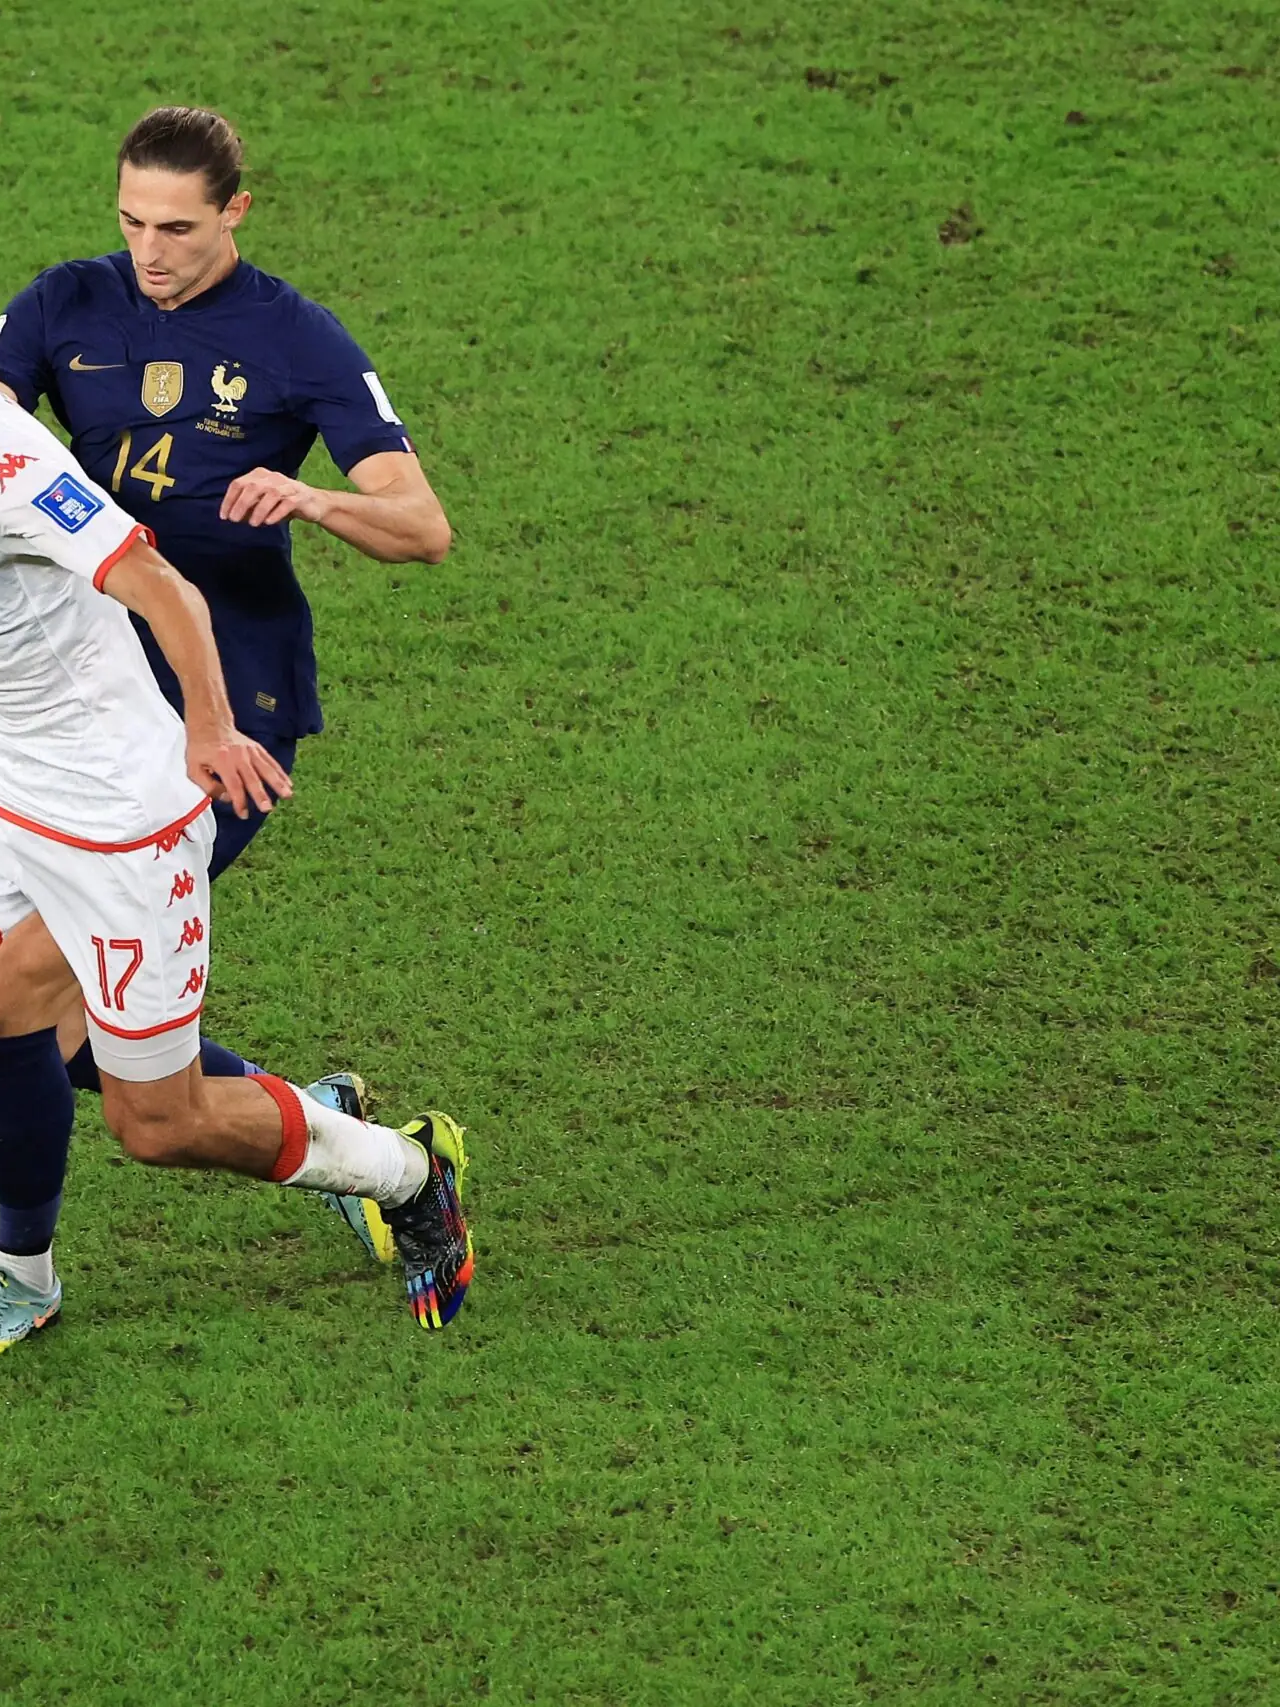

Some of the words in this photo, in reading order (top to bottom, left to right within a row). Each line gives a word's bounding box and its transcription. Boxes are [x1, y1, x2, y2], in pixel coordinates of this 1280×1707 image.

[153, 396, 170, 404] FIFA
[112, 431, 175, 501] 14
[91, 935, 143, 1011] 17
